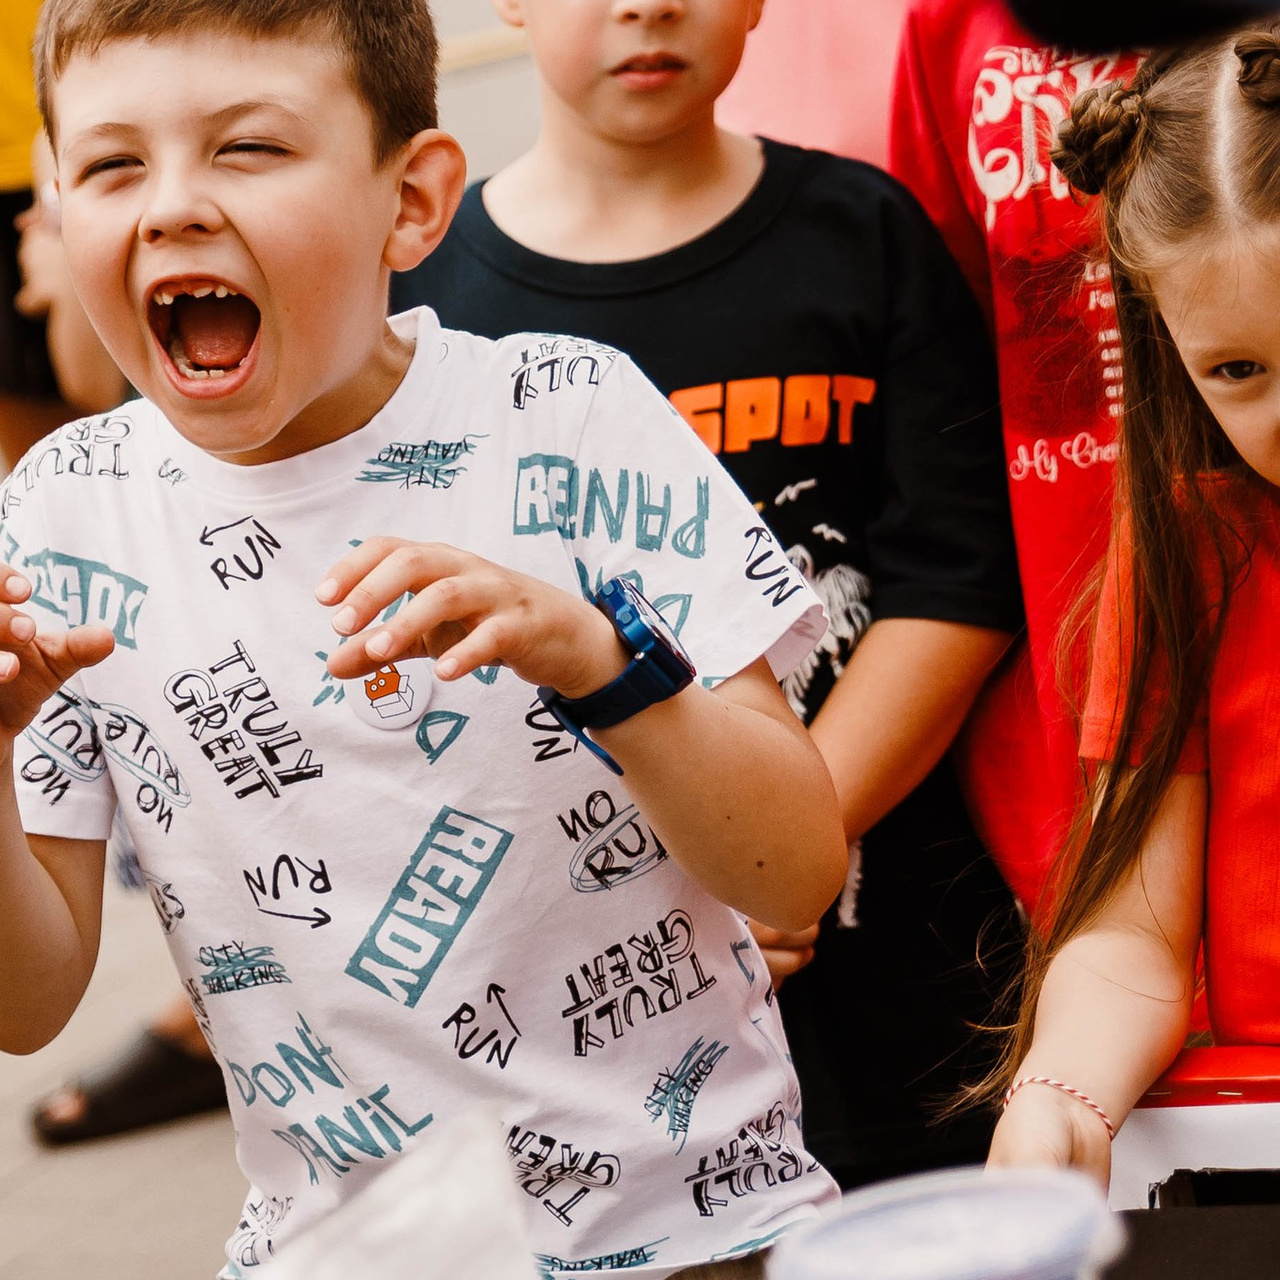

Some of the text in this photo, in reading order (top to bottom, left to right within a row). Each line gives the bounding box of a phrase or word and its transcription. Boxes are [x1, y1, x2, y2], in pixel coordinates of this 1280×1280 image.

[210, 519, 282, 591] RUN
[744, 526, 804, 608] RUN
[164, 669, 280, 799] GREAT
[209, 639, 323, 786] TRULY
[242, 854, 332, 907] RUN
[358, 809, 504, 1002] READY
[198, 940, 247, 967] CITY
[562, 909, 695, 1018] GREAT
[442, 1002, 518, 1069] RUN
[573, 952, 717, 1057] TRULY
[643, 1066, 678, 1117] CITY
